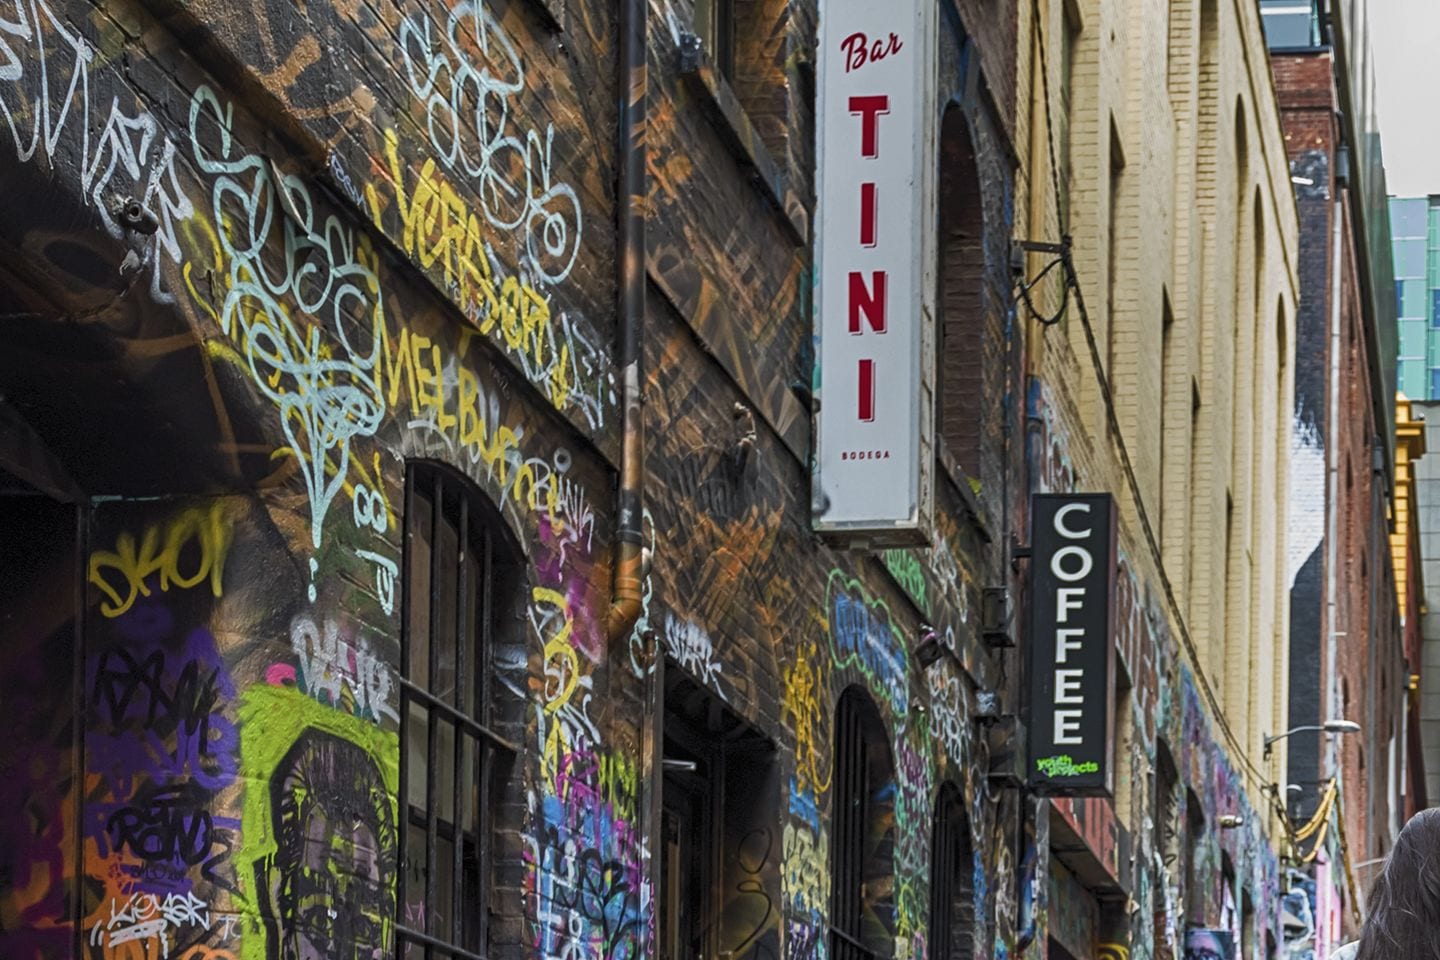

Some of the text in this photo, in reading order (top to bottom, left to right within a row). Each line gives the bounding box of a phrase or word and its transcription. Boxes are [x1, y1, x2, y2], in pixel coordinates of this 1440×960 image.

[840, 32, 902, 72] Bar
[848, 95, 889, 422] TINI
[842, 450, 890, 460] BODEGA
[1050, 502, 1093, 745] COFFEE
[1036, 755, 1072, 772] youth
